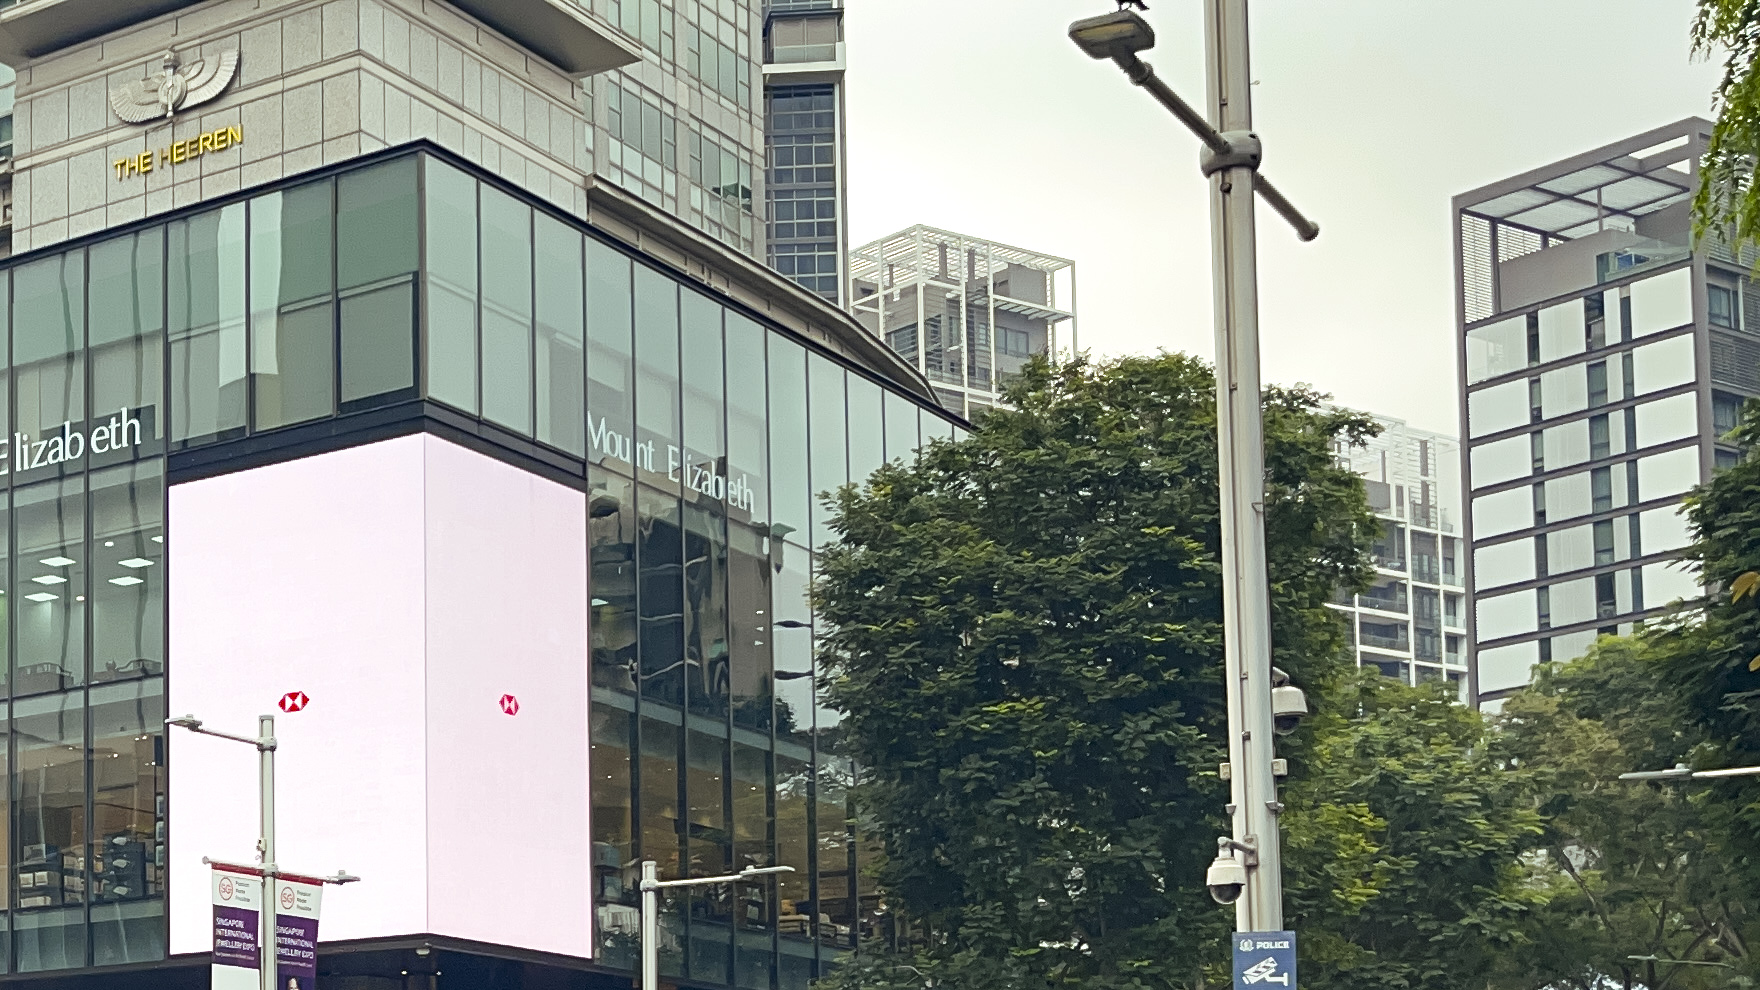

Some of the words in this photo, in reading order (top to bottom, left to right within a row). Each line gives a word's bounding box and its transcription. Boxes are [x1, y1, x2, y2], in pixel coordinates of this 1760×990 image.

[113, 150, 154, 181] THE
[159, 123, 243, 169] HEEREN
[587, 410, 656, 474] Mount
[667, 443, 755, 514] Elizabeth
[1256, 941, 1290, 950] POLICE
